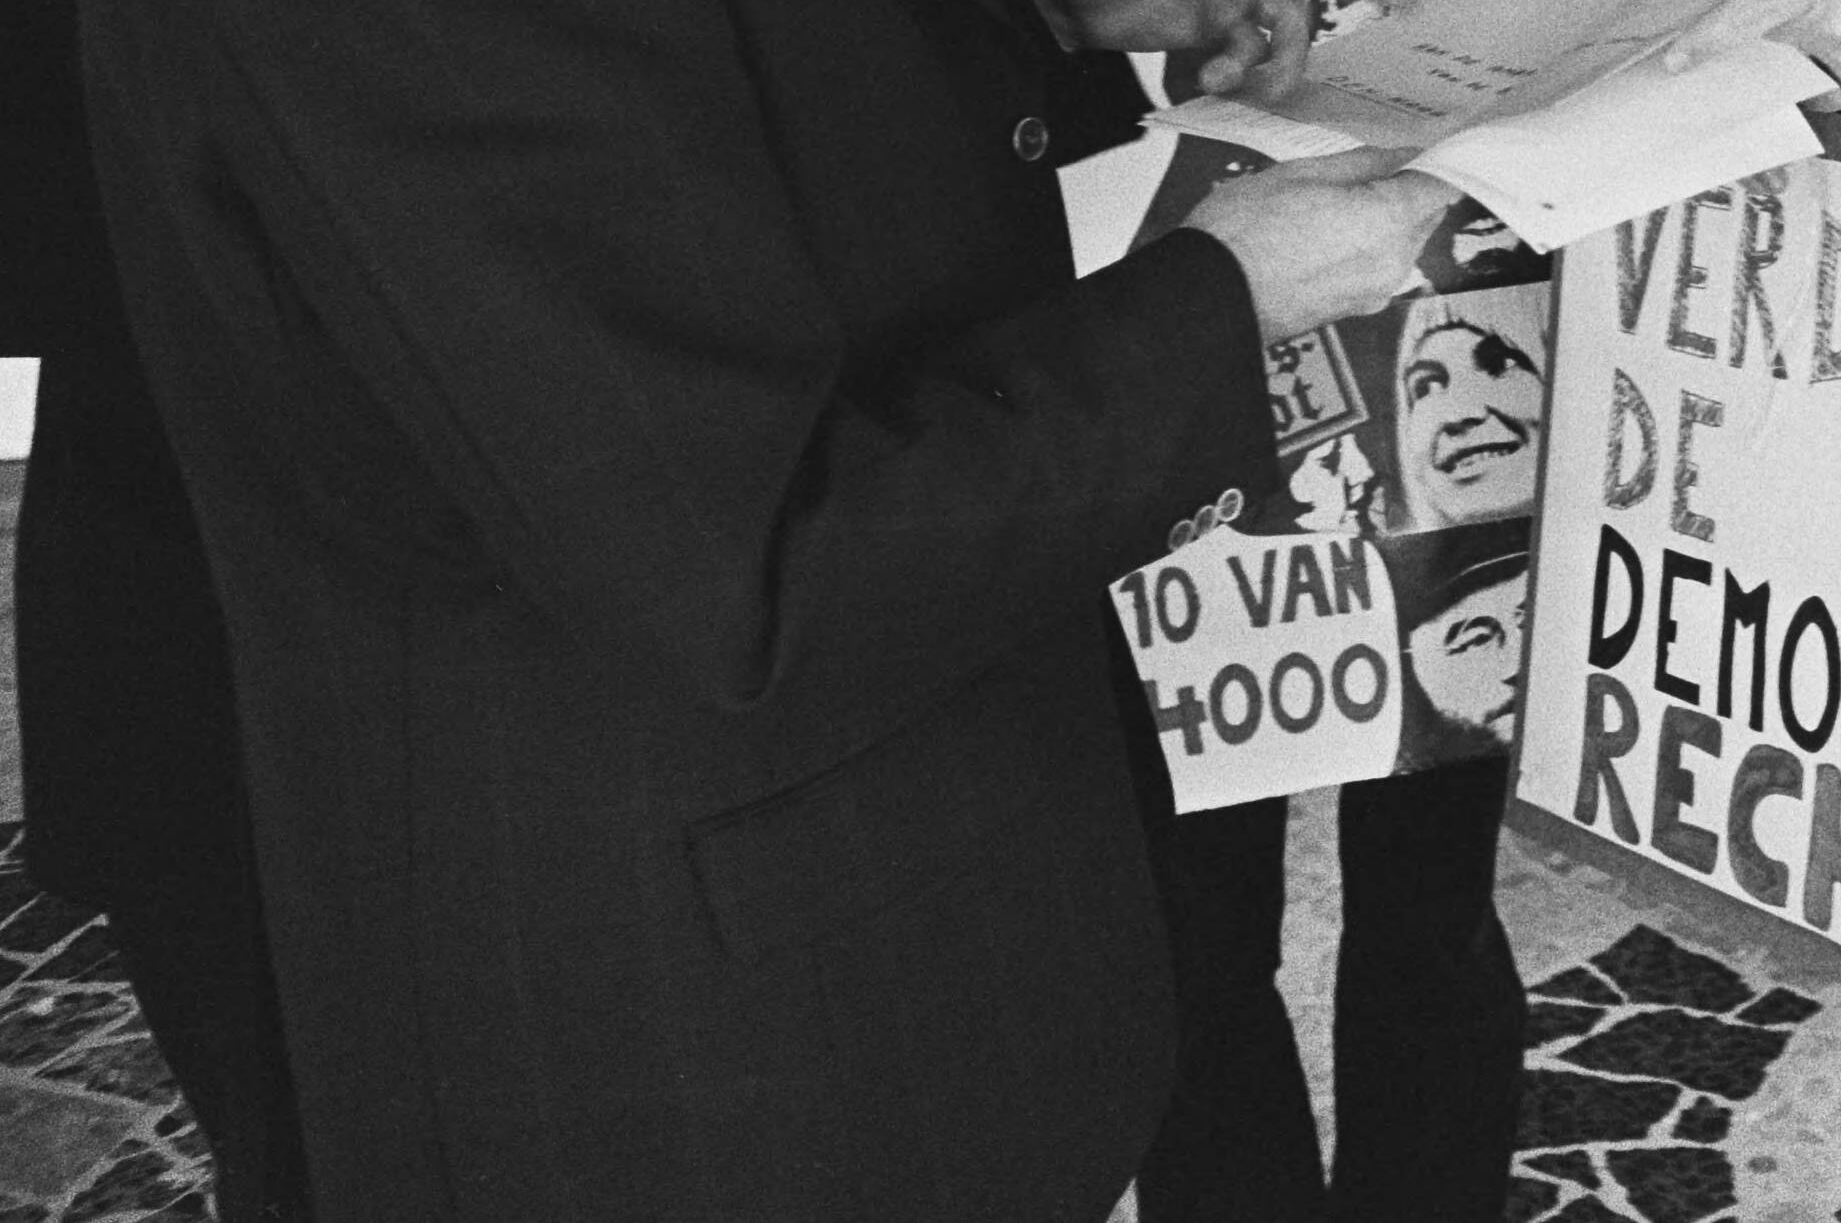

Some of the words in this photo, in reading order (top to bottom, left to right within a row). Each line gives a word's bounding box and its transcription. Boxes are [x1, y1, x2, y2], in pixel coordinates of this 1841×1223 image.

[1605, 367, 1723, 542] DE
[1119, 566, 1201, 649] 10
[1226, 537, 1373, 628] VAN
[1142, 642, 1389, 757] 4000
